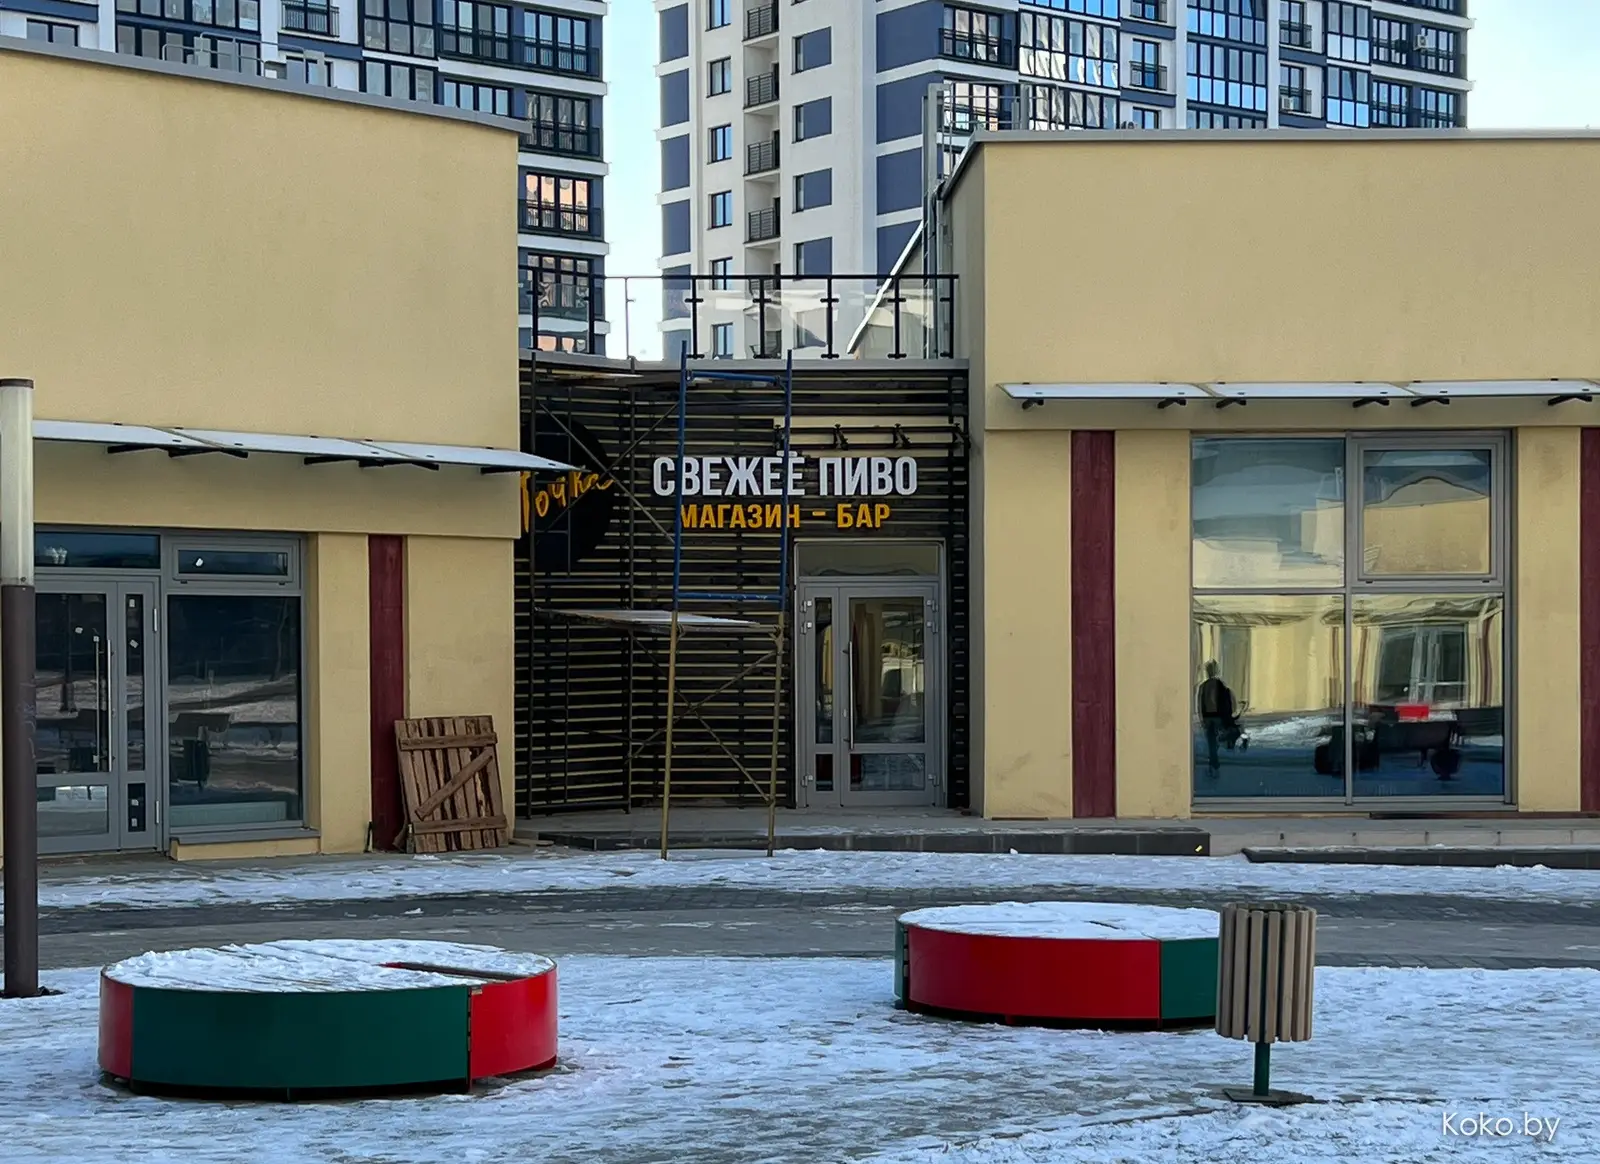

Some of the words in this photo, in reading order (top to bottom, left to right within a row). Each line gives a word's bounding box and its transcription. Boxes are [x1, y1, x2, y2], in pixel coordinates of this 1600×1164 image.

[819, 456, 918, 496] ПИВО
[680, 503, 801, 529] МАГАЗИН
[837, 503, 891, 529] БАР
